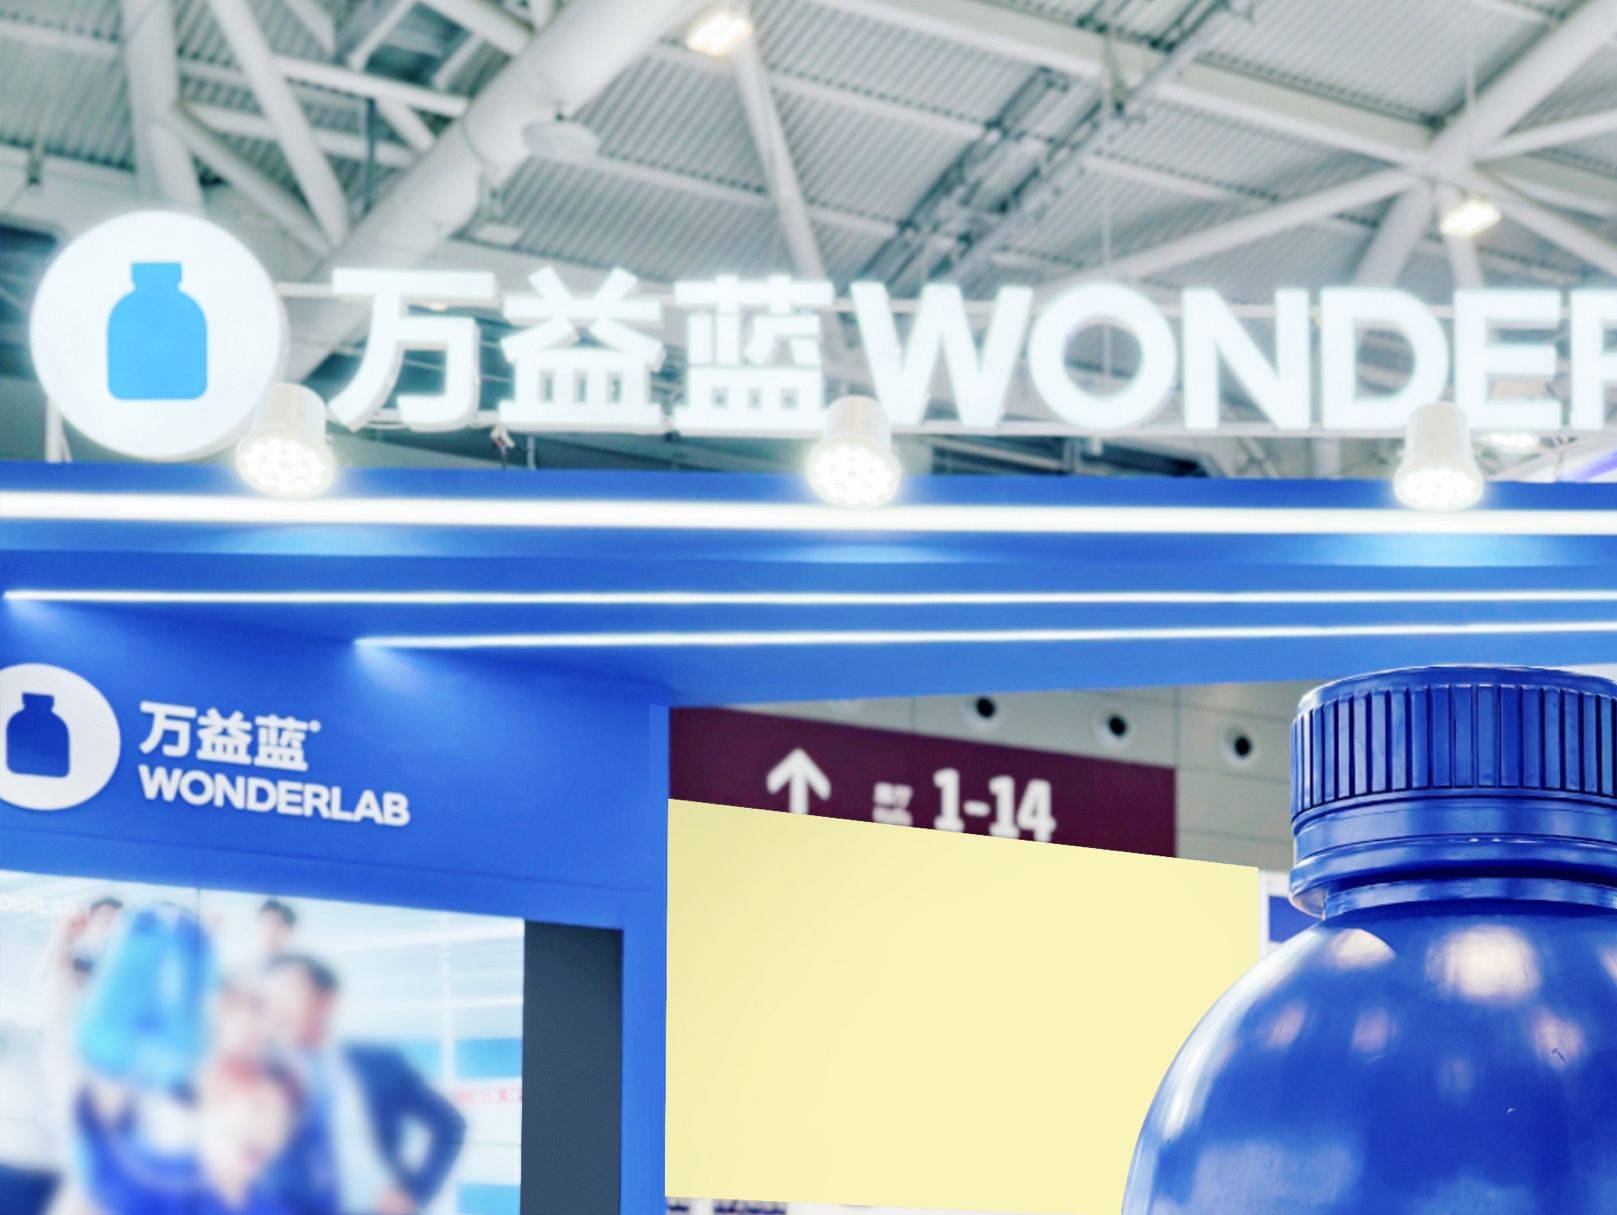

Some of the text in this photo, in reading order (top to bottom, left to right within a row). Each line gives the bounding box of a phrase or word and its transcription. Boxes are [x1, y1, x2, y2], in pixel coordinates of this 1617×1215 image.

[328, 266, 836, 435] 万益蓝
[139, 700, 309, 772] 万益蓝
[138, 763, 411, 827] WONDERLAB
[933, 767, 1057, 843] 1-14
